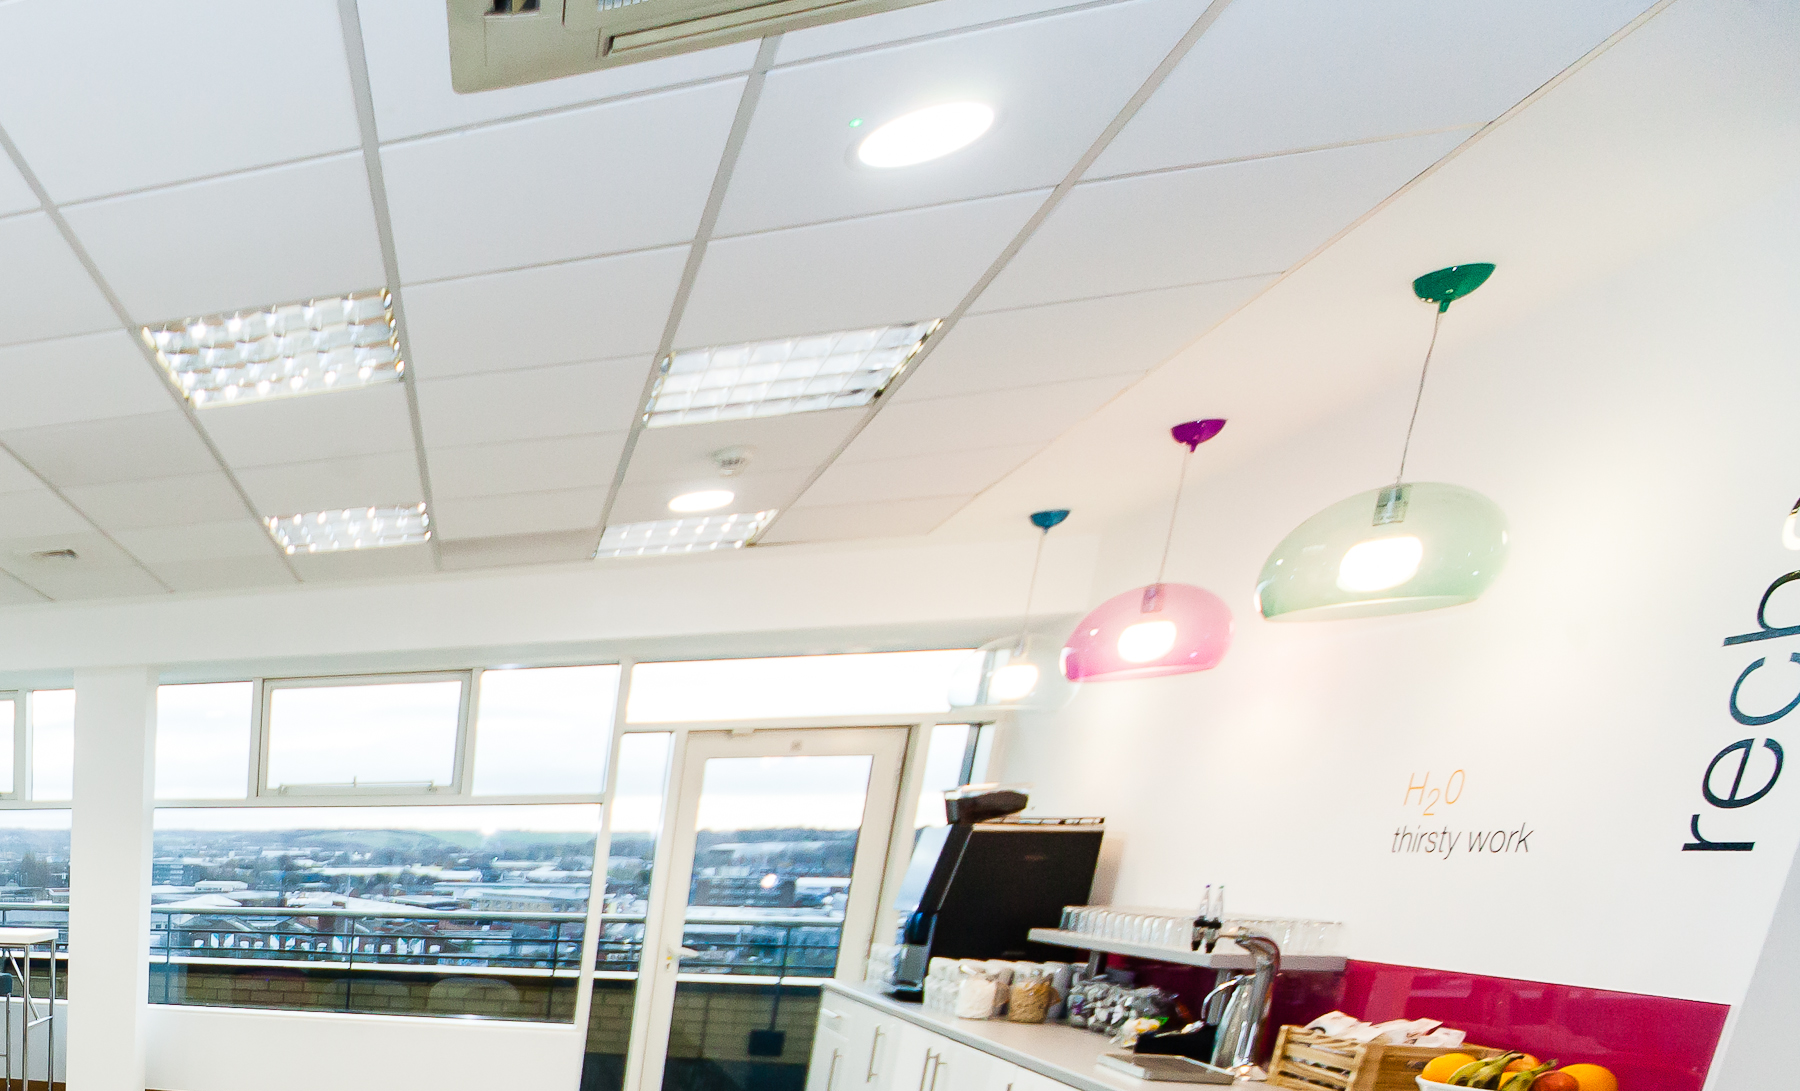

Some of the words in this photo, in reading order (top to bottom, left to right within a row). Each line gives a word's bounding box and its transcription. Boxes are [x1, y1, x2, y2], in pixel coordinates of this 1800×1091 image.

[1681, 497, 1800, 852] rech
[1391, 825, 1462, 860] thirsty
[1468, 822, 1534, 853] work
